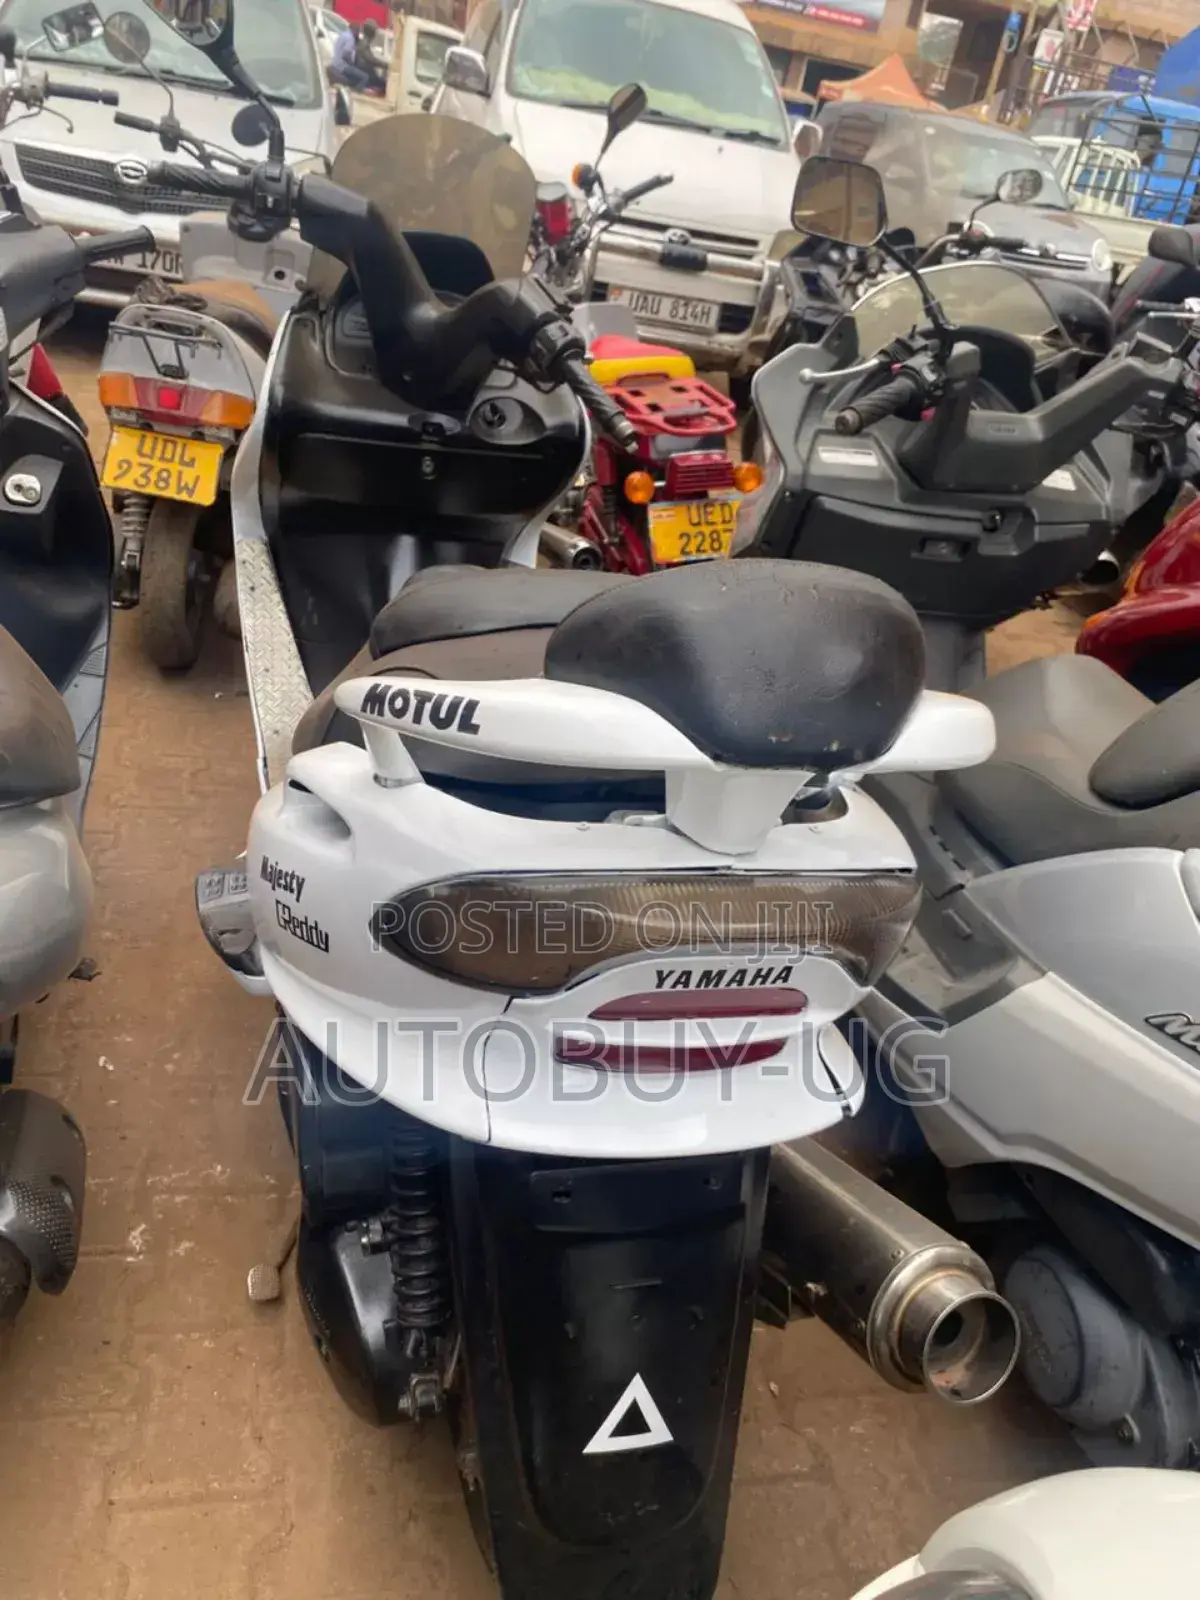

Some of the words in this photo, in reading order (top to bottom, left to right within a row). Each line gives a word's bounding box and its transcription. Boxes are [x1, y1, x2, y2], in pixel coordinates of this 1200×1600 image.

[628, 291, 661, 316] UAU
[669, 300, 711, 323] 814H
[136, 434, 196, 468] UDL
[113, 459, 200, 498] 938W
[687, 501, 733, 526] UED
[360, 683, 481, 735] MOTUL
[260, 855, 305, 902] Majesty
[655, 966, 793, 989] YAMAHA
